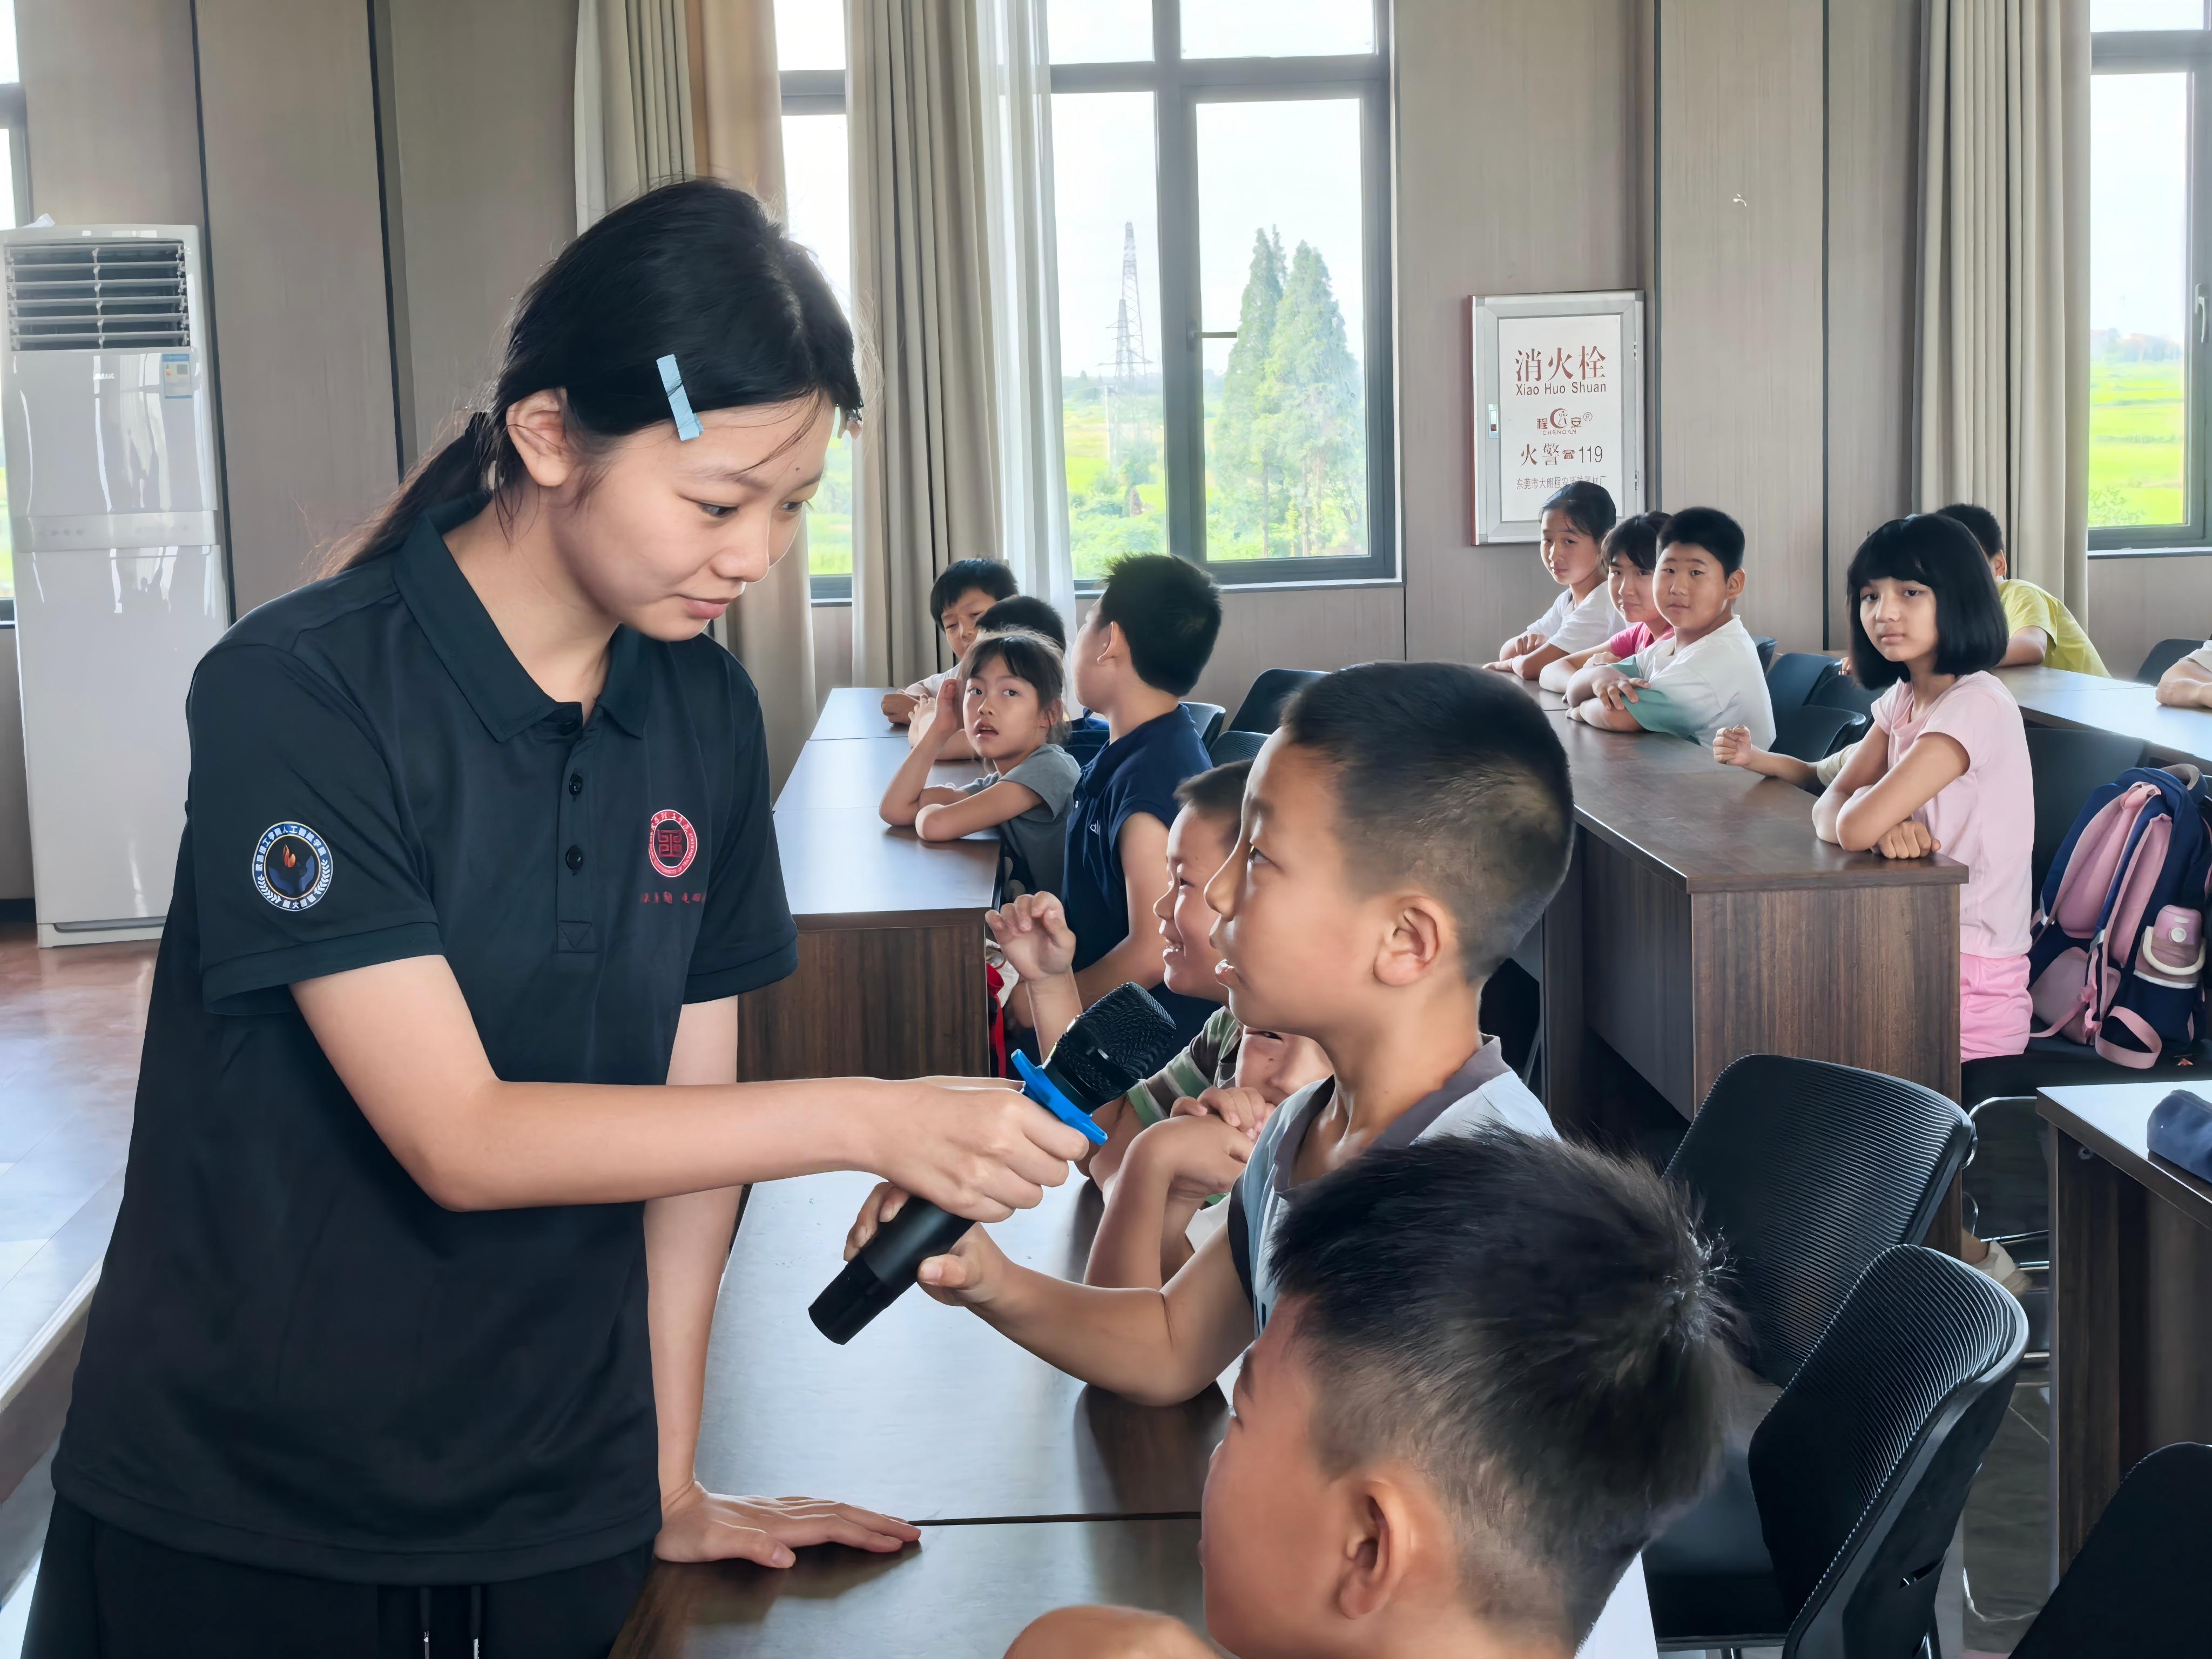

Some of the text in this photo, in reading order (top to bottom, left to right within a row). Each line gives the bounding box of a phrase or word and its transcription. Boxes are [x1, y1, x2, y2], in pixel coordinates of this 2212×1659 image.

[1515, 346, 1606, 382] 消火栓
[1516, 381, 1606, 396] Xiao Huo Shuan
[1520, 443, 1603, 467] 火警 119
